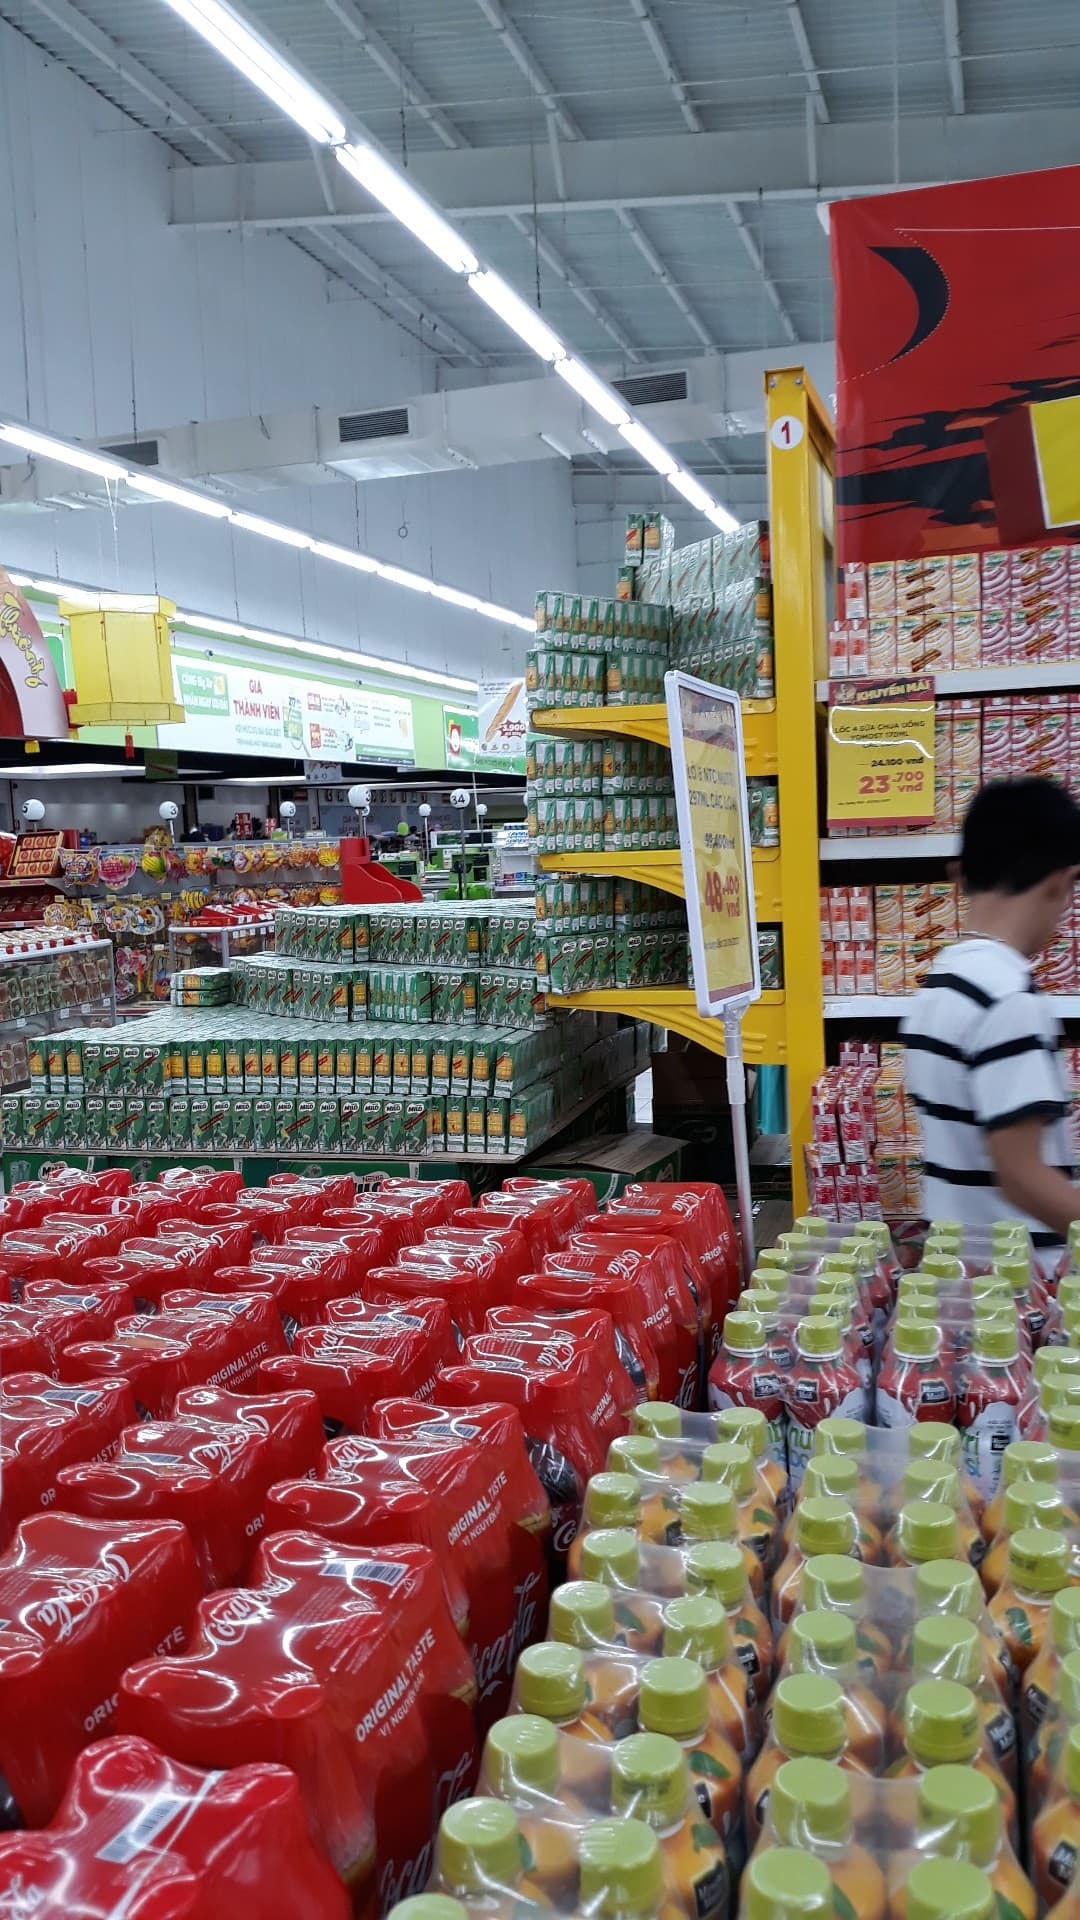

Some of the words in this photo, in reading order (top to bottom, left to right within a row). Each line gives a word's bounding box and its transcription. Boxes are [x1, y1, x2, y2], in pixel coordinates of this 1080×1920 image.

[781, 421, 790, 444] 1
[859, 775, 890, 795] 23
[451, 793, 466, 805] 34
[206, 1358, 248, 1386] ORIGINAL
[246, 1341, 268, 1361] TASTE
[356, 1672, 411, 1743] ORIGINAL
[404, 1628, 437, 1675] TASTE
